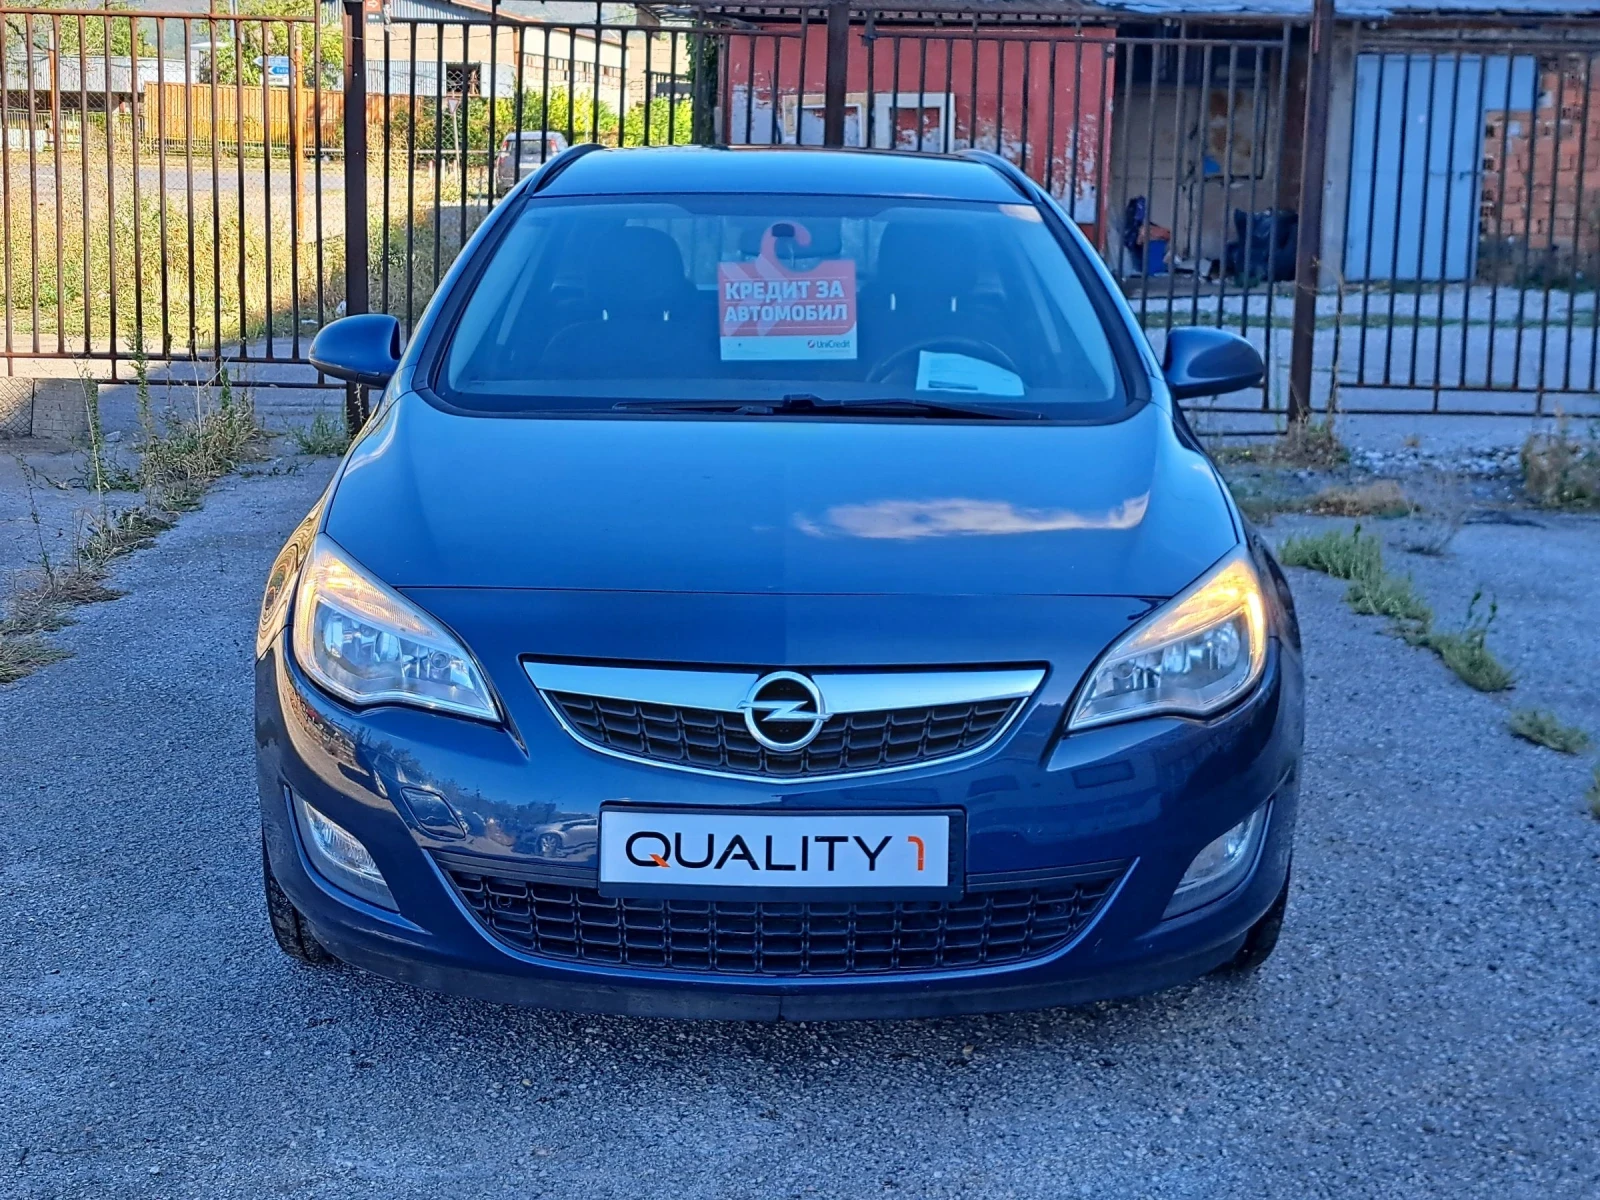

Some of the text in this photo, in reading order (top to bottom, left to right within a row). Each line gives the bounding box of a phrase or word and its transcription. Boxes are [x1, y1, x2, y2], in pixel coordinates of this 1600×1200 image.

[725, 280, 844, 302] КРЕДИТ ЗА
[724, 304, 847, 321] АВТОМОБИЛ
[816, 340, 850, 348] UniCredit
[625, 831, 925, 872] QUALITY 1
